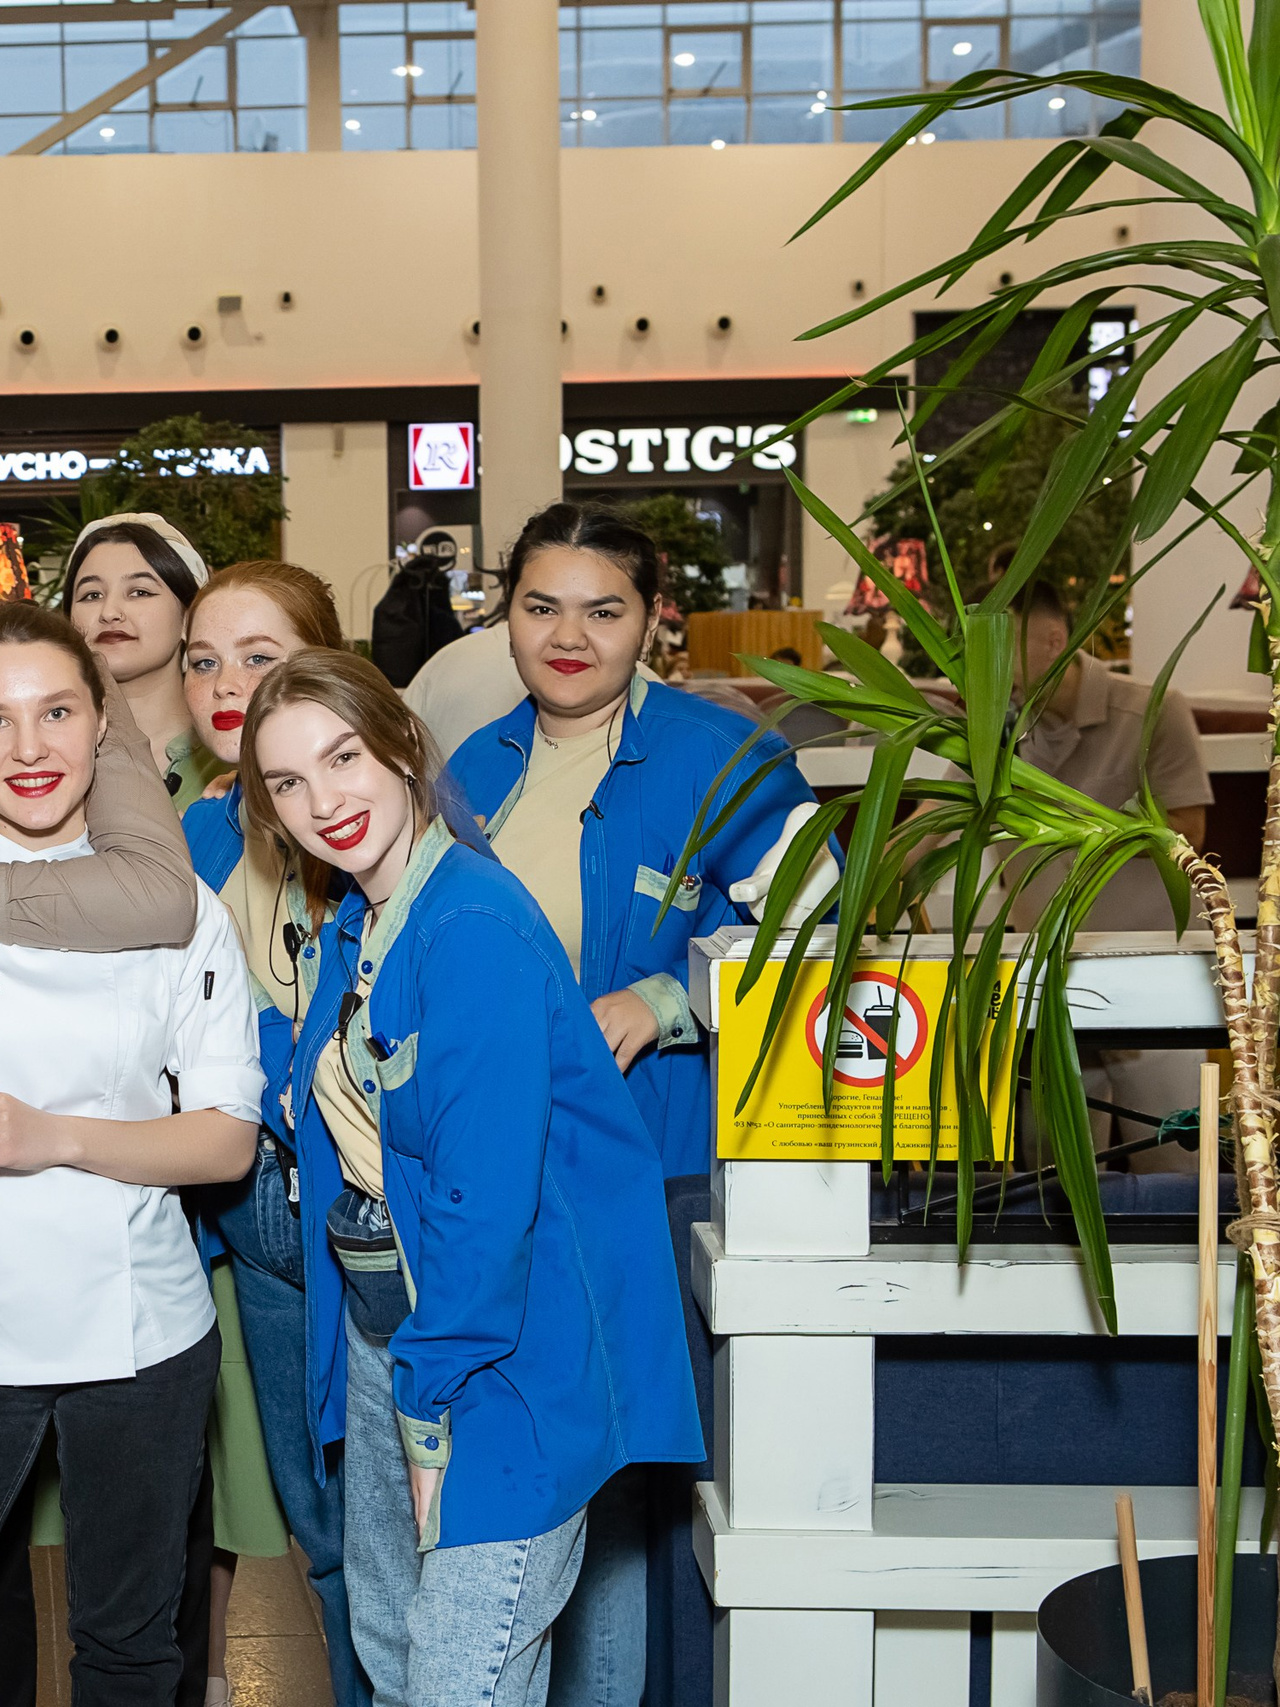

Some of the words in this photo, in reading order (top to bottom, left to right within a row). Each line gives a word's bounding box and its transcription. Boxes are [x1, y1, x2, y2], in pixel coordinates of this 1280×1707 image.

[560, 424, 797, 474] STIC'S
[832, 1093, 861, 1102] орогие,
[778, 1102, 825, 1110] Употреблени
[832, 1103, 871, 1111] продуктов
[853, 1112, 876, 1120] собой
[878, 1112, 931, 1121] ЗРЕЩЕНО
[775, 1122, 897, 1130] санитарно-эпидемиологичесм
[833, 1141, 878, 1149] грузинский
[895, 1141, 958, 1149] Аджикиналь»
